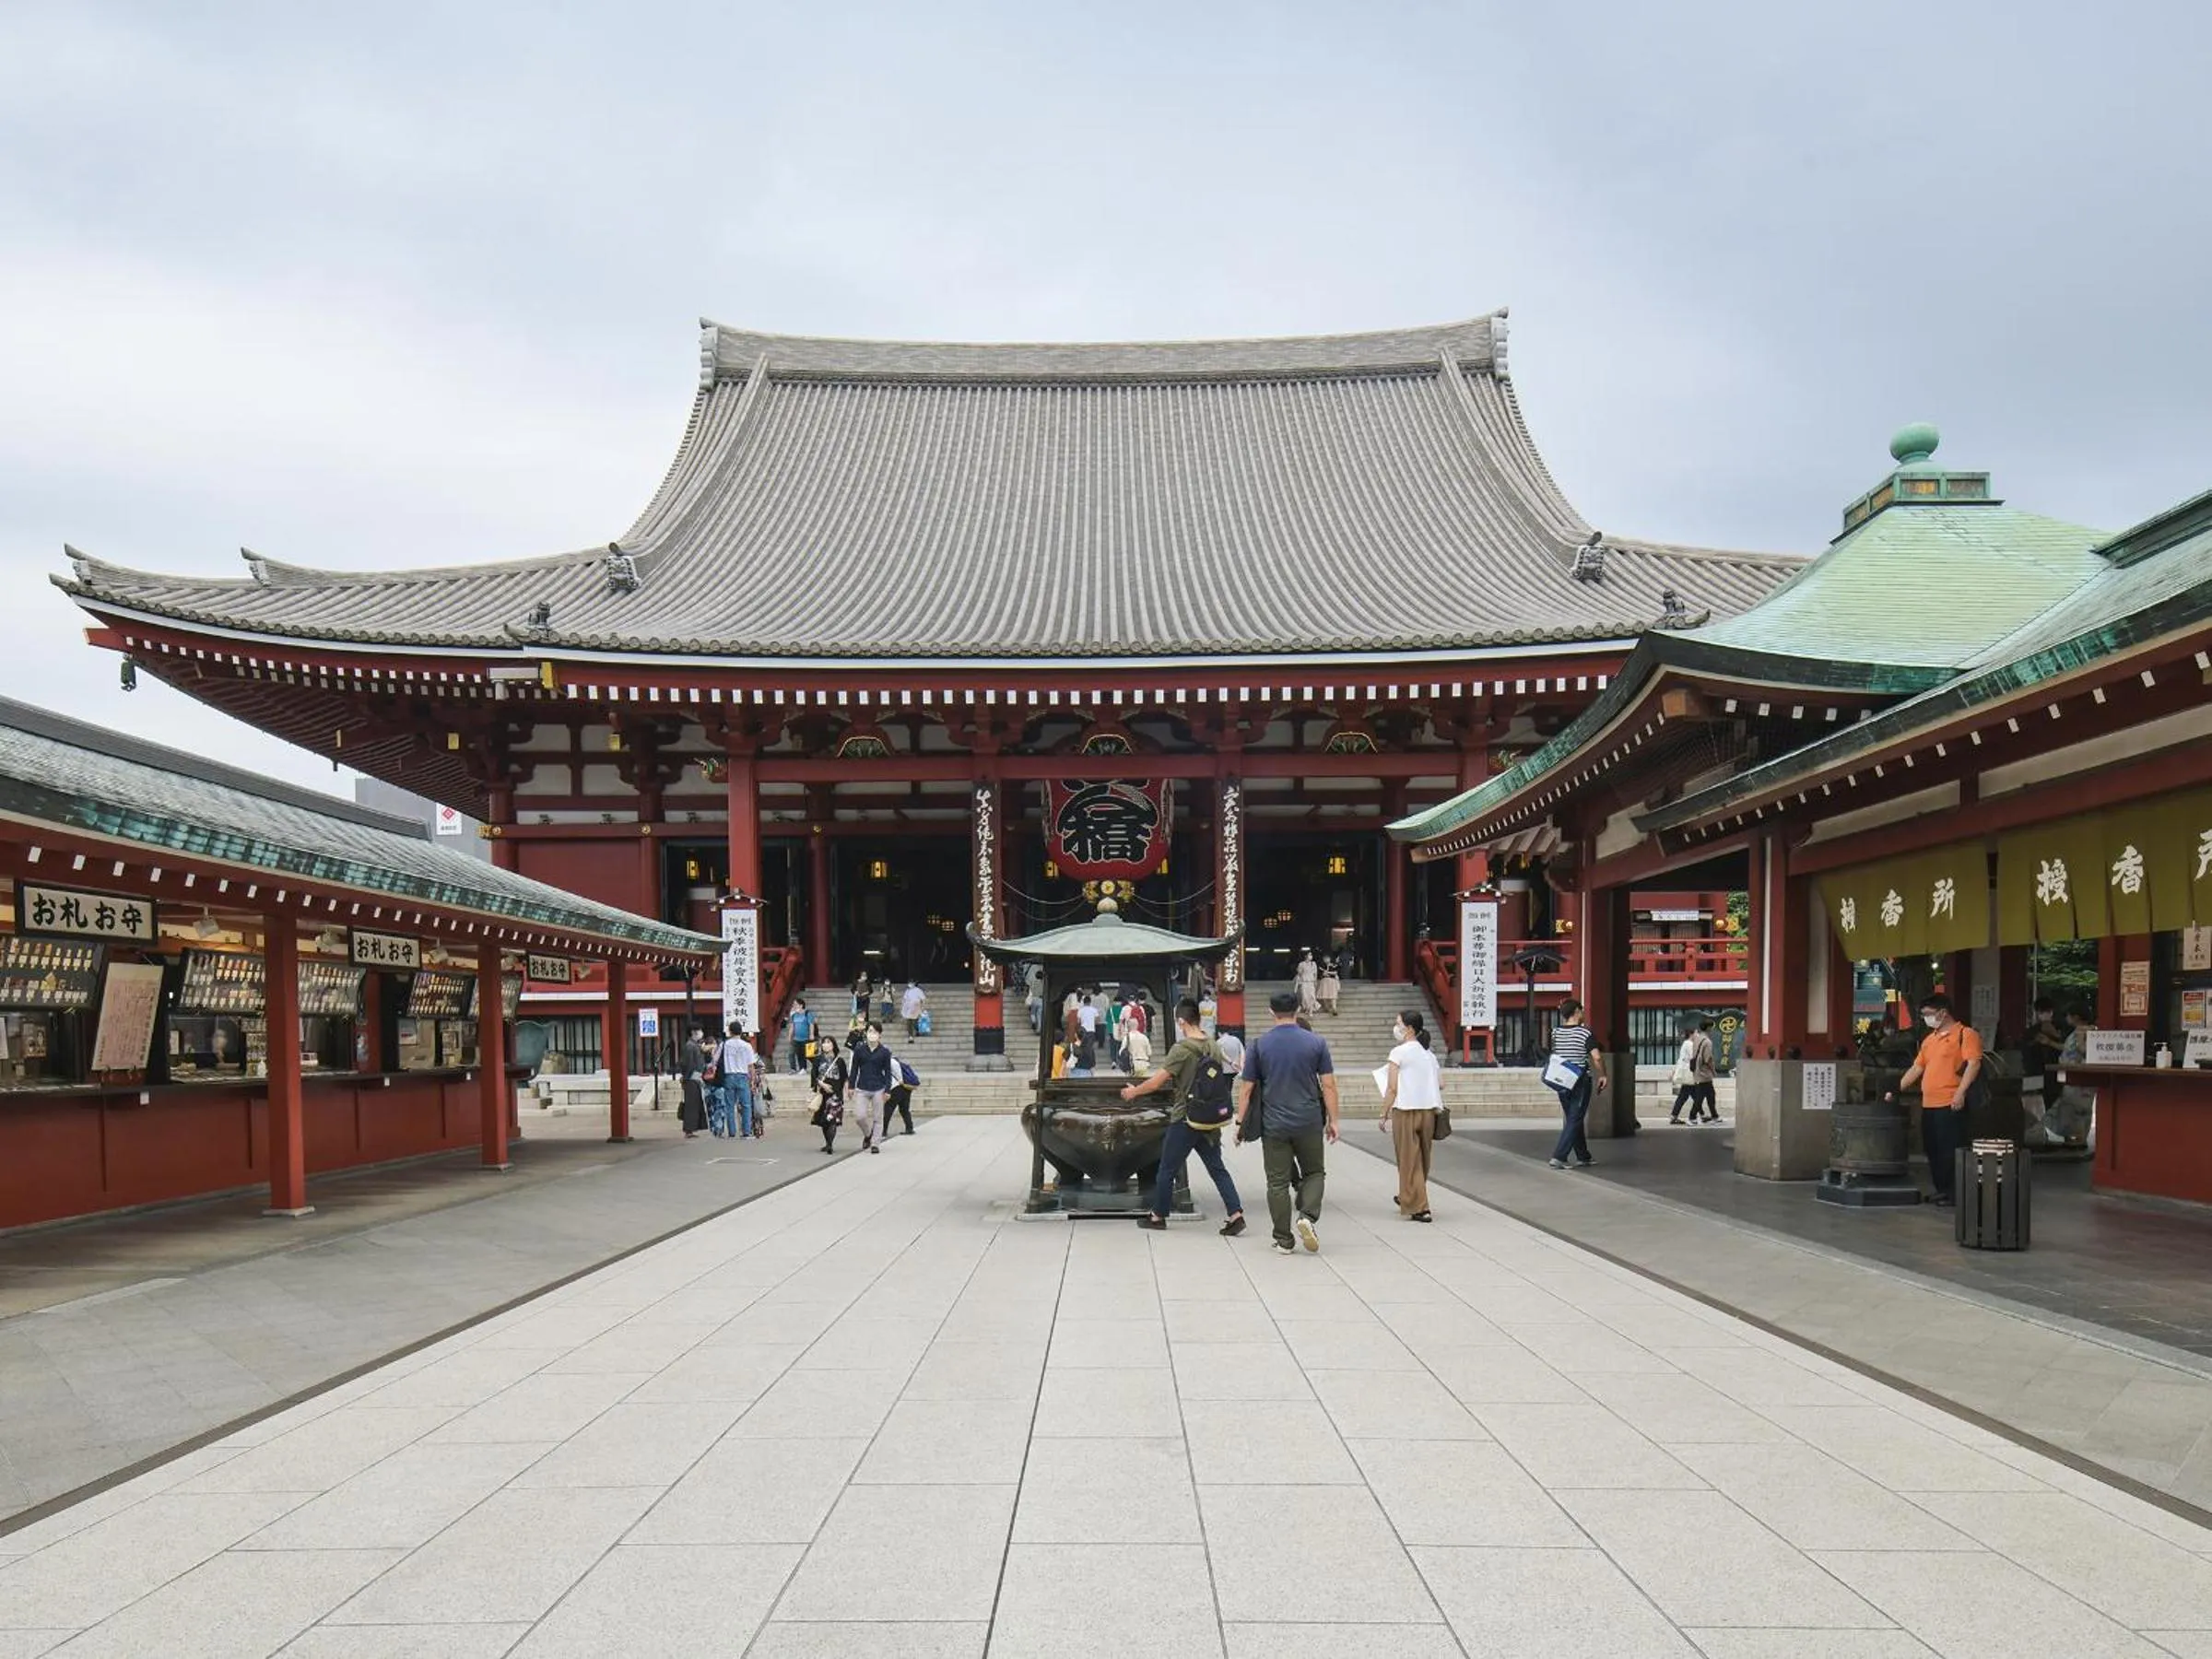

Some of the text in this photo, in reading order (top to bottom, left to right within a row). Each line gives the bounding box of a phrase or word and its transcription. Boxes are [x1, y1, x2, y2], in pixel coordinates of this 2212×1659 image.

[32, 893, 143, 935] お札お守
[357, 936, 414, 963] お札お守
[531, 958, 568, 979] お札お守
